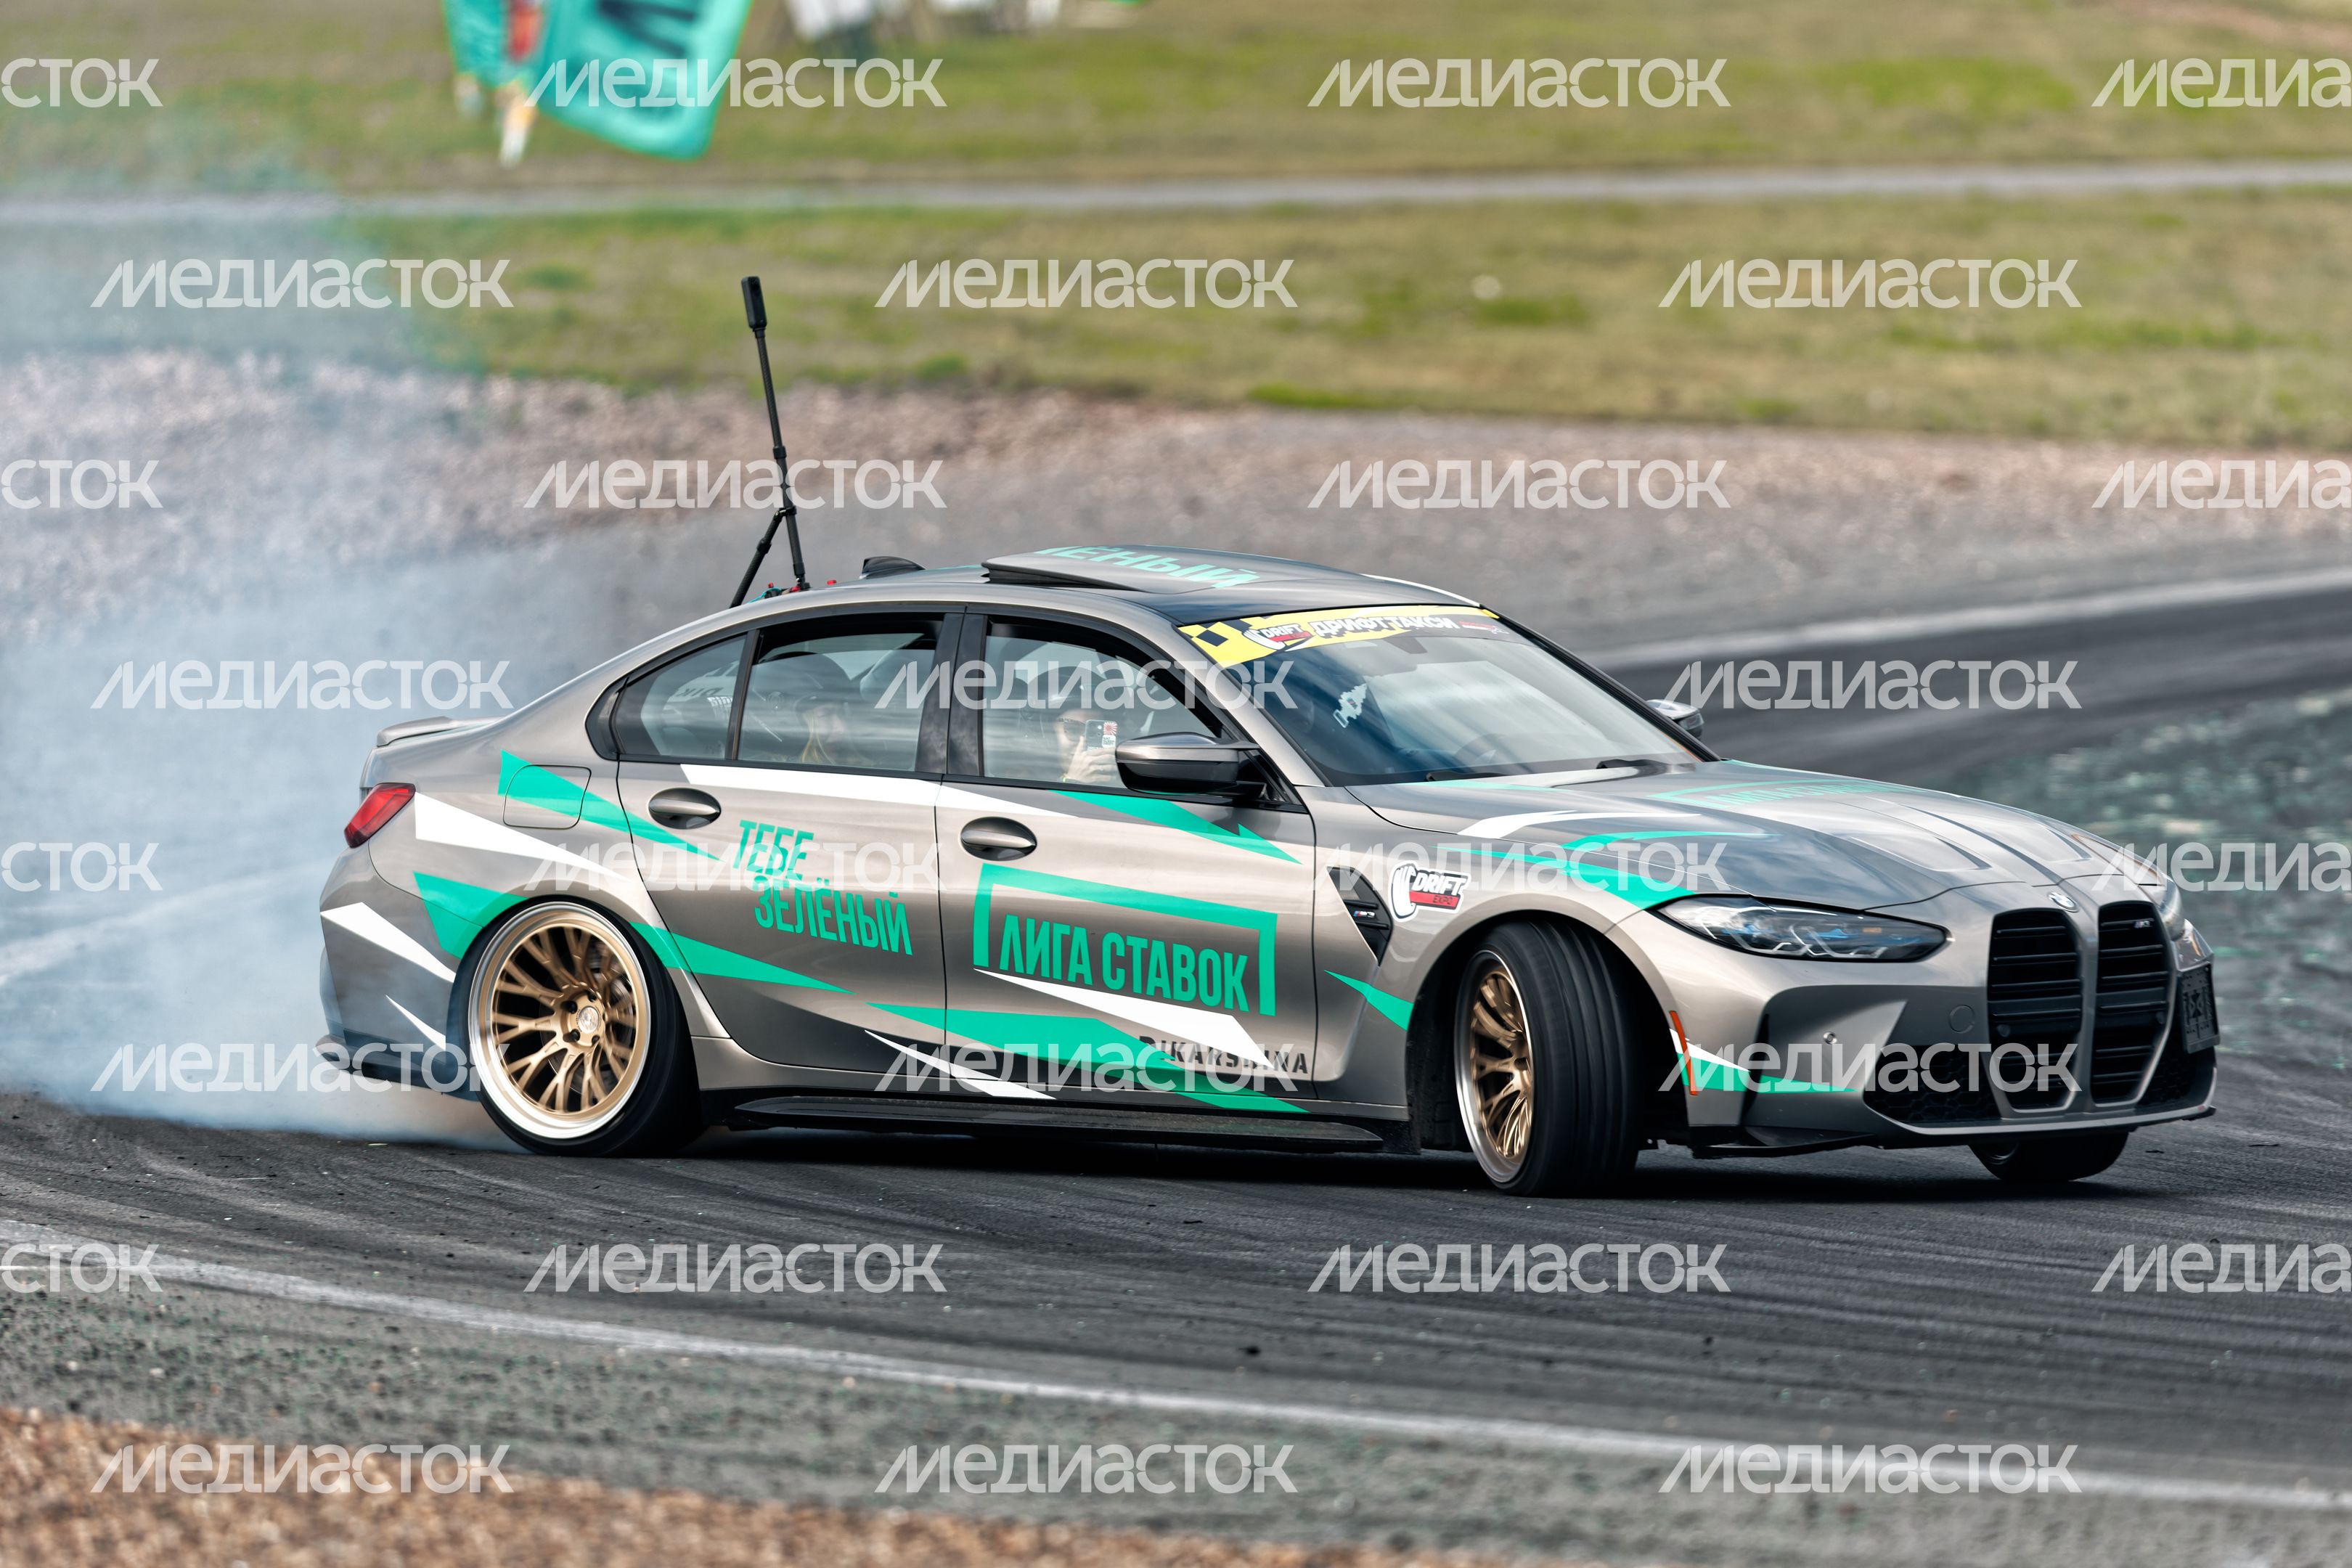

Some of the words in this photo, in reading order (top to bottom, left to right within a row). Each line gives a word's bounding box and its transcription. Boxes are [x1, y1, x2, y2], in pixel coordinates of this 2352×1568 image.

[1260, 623, 1304, 638] DRIFT
[732, 820, 814, 881] ТЕБЕ
[752, 875, 913, 955] ЗЕЛЁНЫЙ
[1411, 872, 1467, 897] DRIFT
[999, 914, 1093, 986] ЛИГА
[1102, 932, 1250, 1013] СТАВОК
